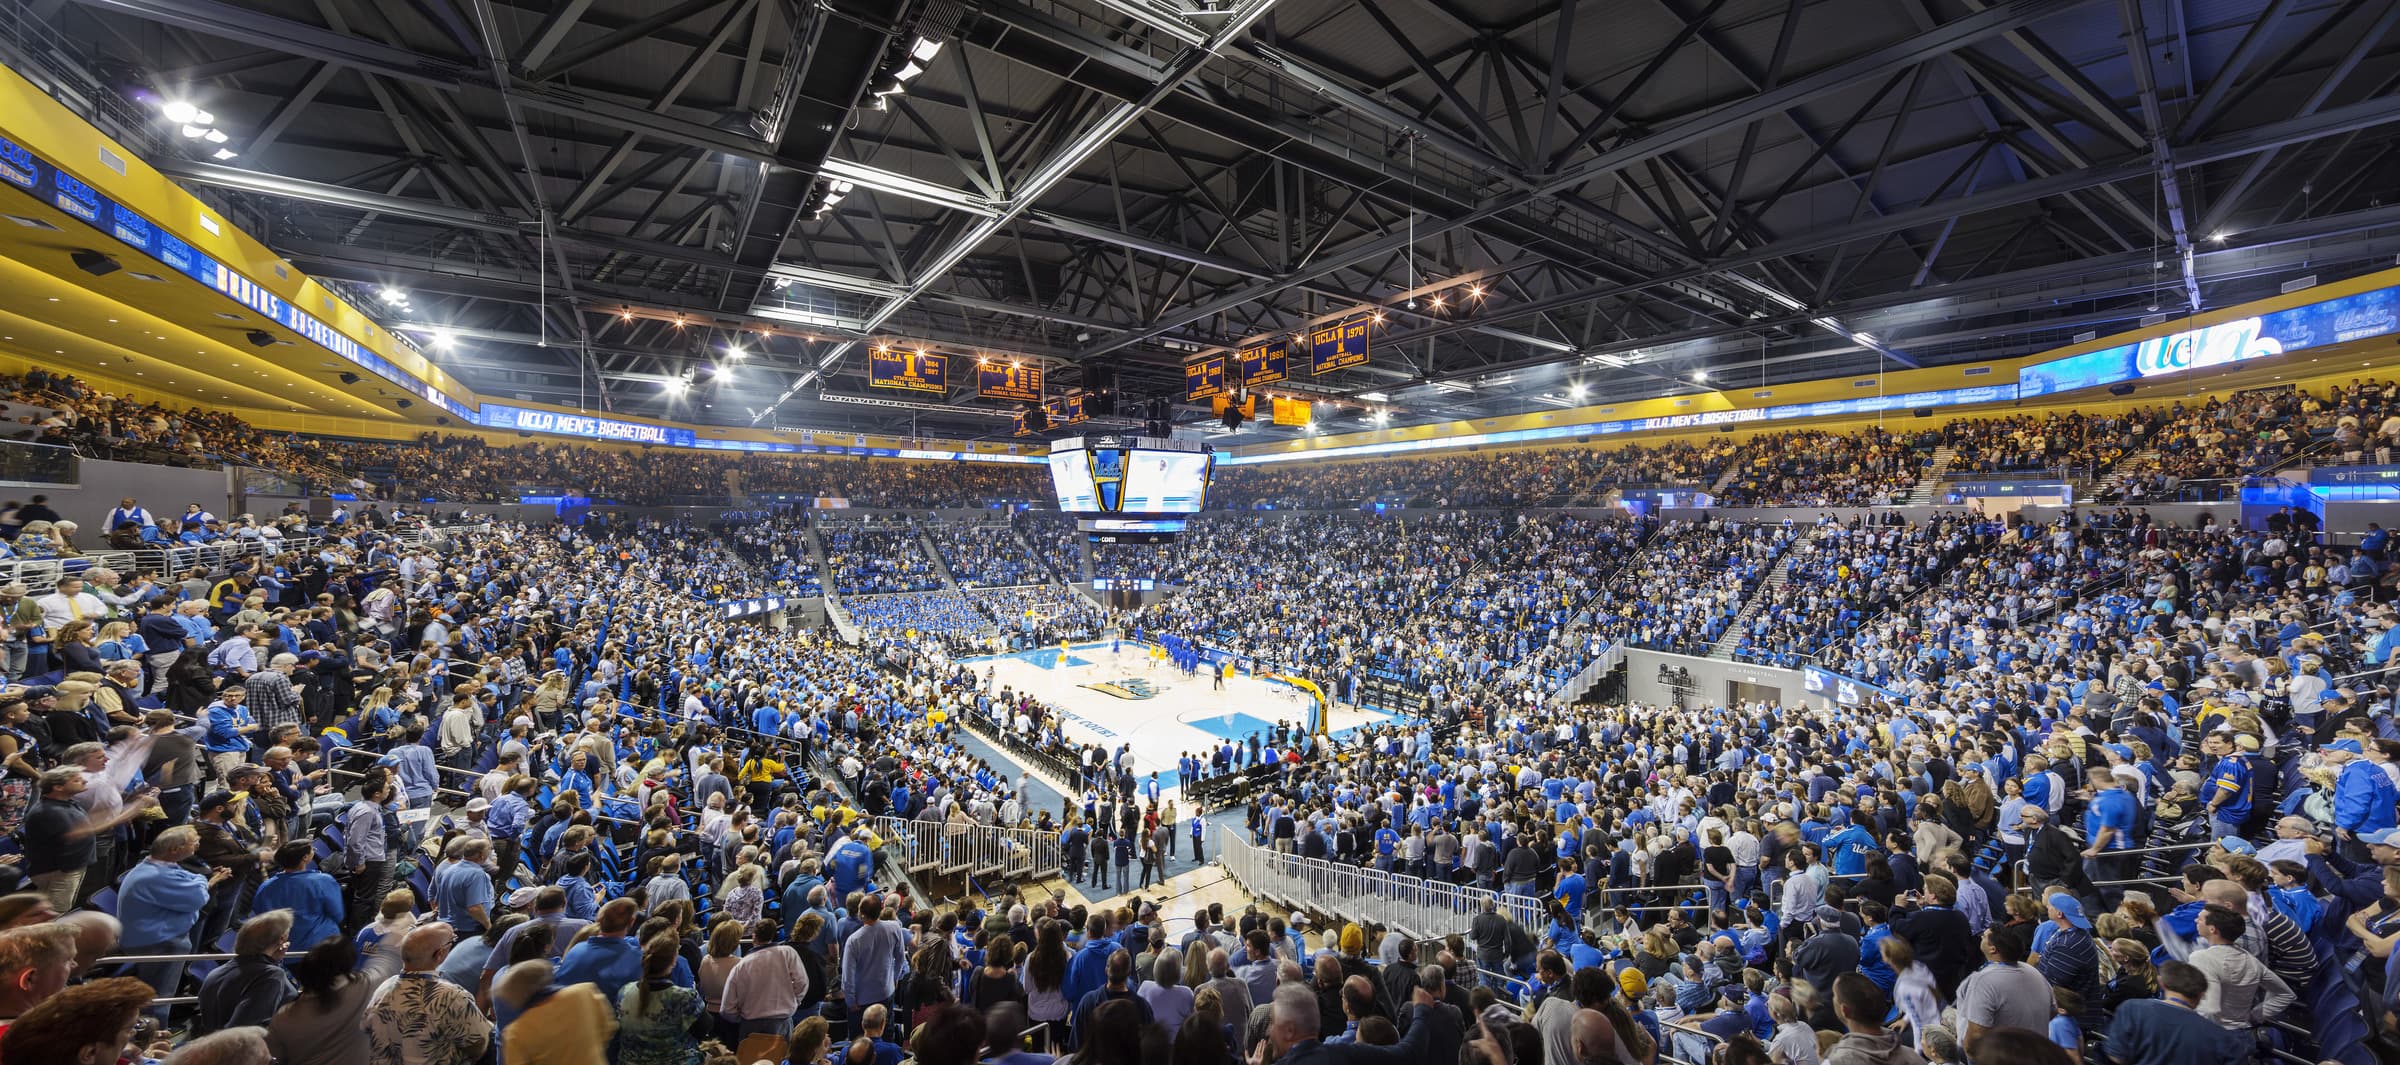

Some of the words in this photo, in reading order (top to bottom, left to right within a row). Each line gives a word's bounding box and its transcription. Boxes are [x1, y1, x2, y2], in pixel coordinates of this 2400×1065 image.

[216, 263, 278, 319] BRUINS
[290, 306, 359, 363] BASKETBALL
[1315, 330, 1337, 346] UCLA
[1336, 327, 1345, 354] 1
[1346, 325, 1364, 339] 1970
[873, 350, 902, 363] UCLA
[903, 354, 917, 377] 1
[1260, 346, 1268, 370] 1
[874, 378, 907, 387] NATIONAL
[907, 381, 943, 391] CHAMPIONS
[1005, 367, 1016, 388] 1
[1201, 362, 1208, 385] 1
[517, 411, 552, 430] UCLA
[556, 416, 596, 434] MEN'S
[597, 421, 666, 443] BASKETBALL
[1646, 416, 1670, 430] UCLA
[1671, 414, 1700, 427] MEN'S
[1702, 407, 1766, 425] BASKETBALL
